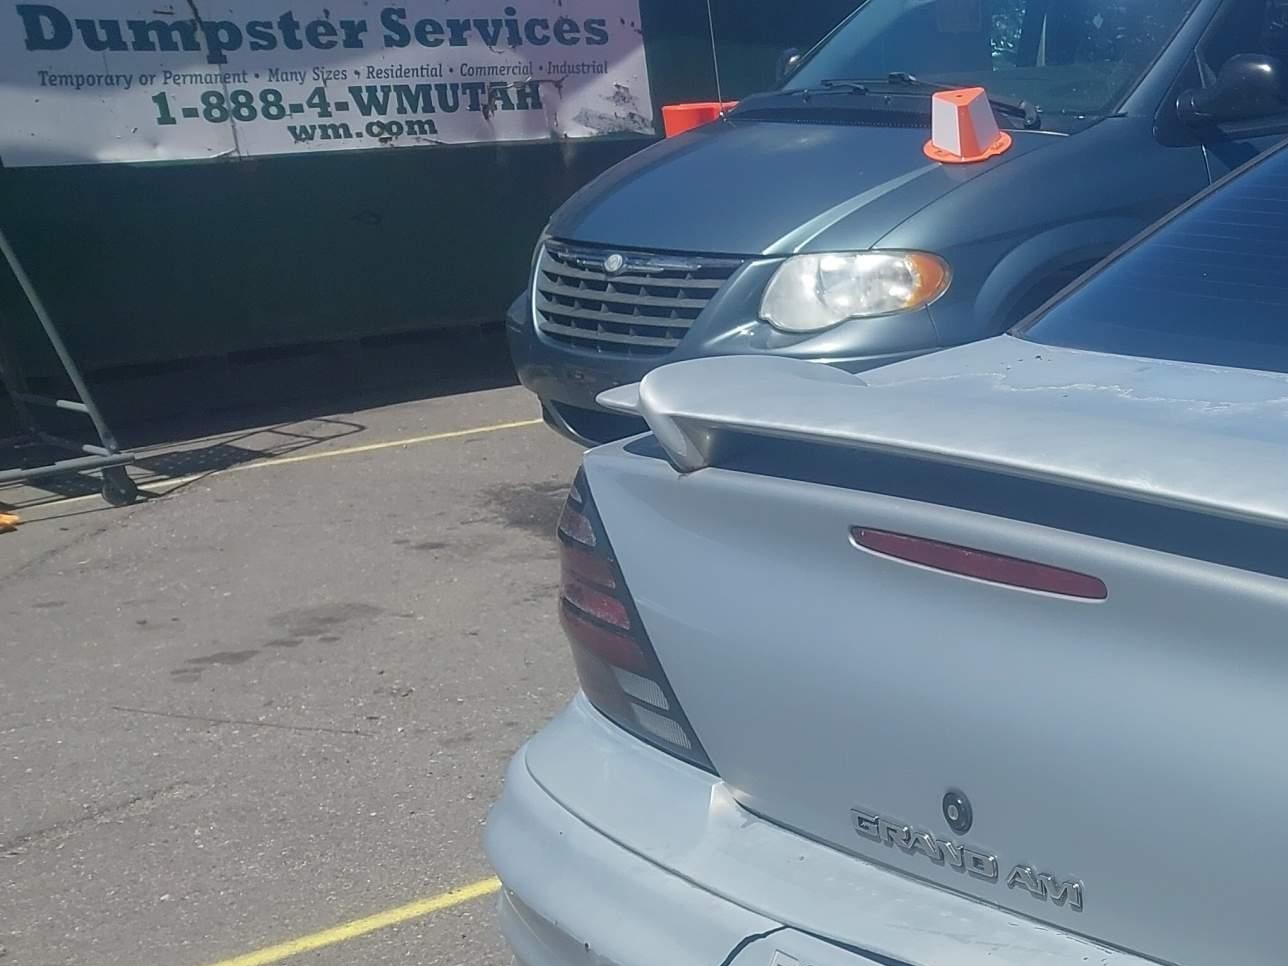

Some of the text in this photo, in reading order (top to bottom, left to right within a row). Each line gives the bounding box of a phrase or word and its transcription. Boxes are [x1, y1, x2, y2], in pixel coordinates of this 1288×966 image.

[16, 4, 609, 65] Dumpster Services
[38, 60, 608, 90] Temporary or Permanent Many Sizes Residential Commercial Industrial
[152, 80, 544, 126] 1-888-4-WMUTAH
[287, 118, 438, 142] wm.com
[850, 807, 1084, 912] GRAND AM
